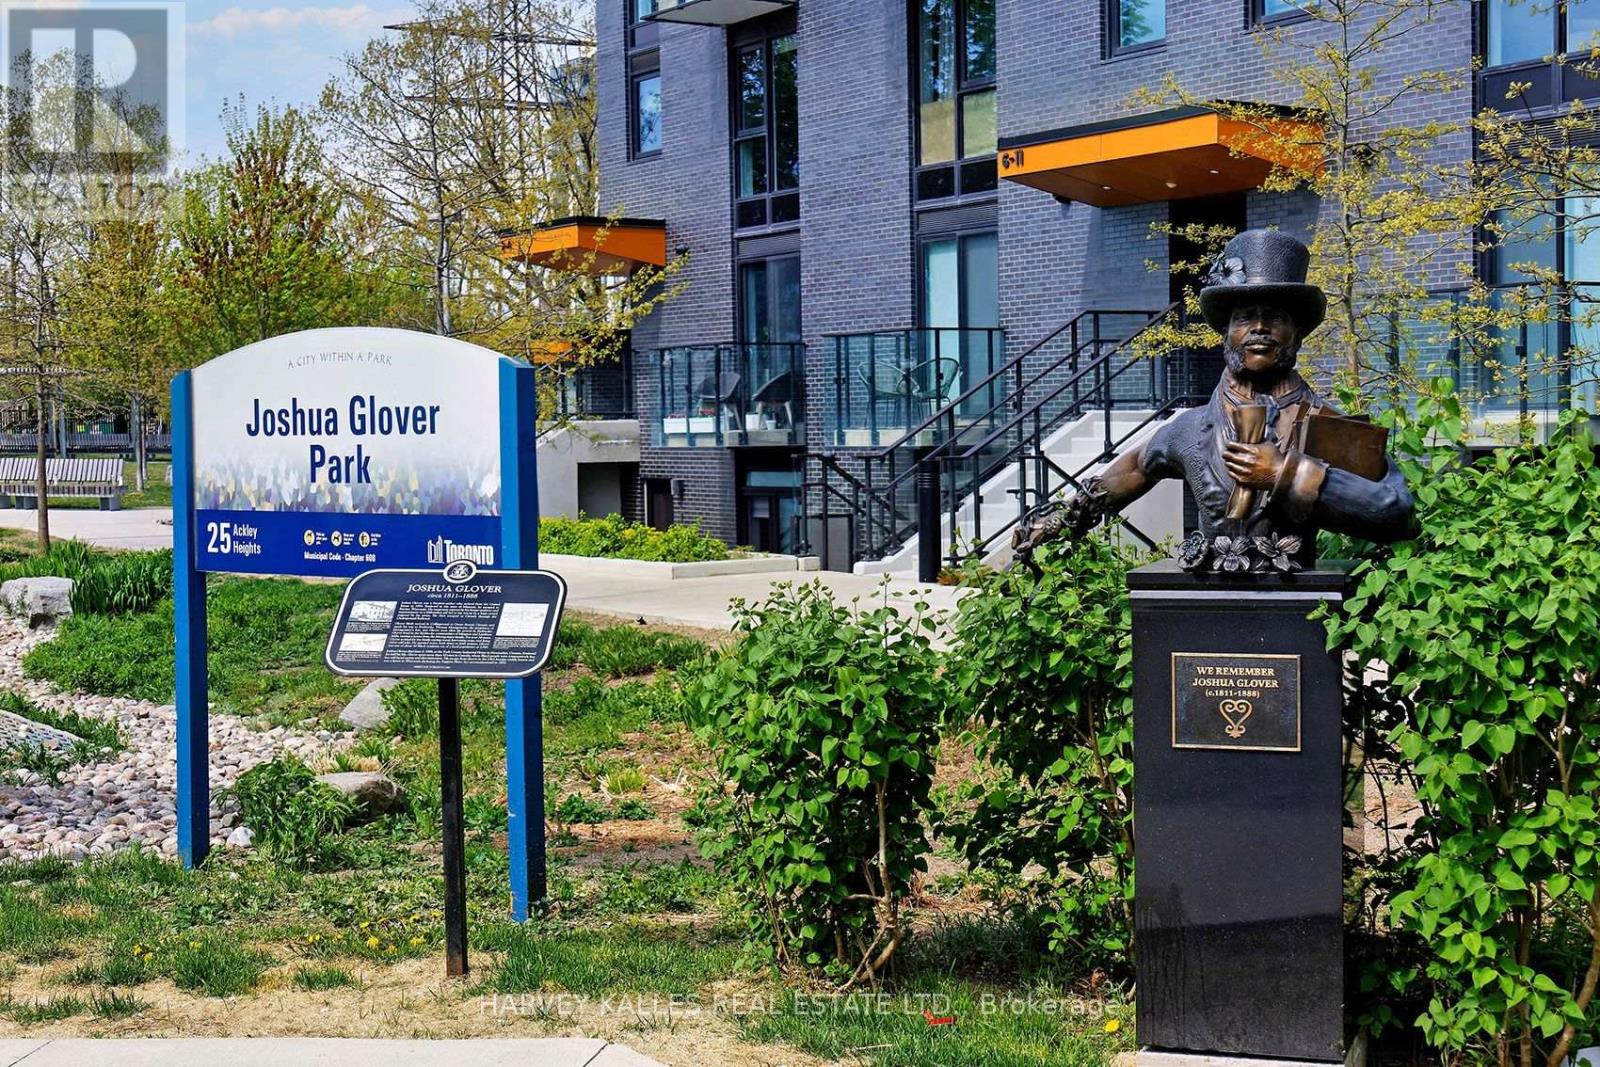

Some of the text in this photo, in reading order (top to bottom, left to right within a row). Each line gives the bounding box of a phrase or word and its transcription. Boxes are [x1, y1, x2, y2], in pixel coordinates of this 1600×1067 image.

[296, 354, 316, 366] CITY
[320, 352, 353, 362] WITHIN
[357, 353, 364, 362] A
[367, 352, 392, 366] PARK
[246, 395, 440, 437] Joshua Glover
[310, 445, 371, 484] Park
[207, 521, 231, 554] 25
[233, 523, 258, 540] Ackley
[233, 540, 261, 557] Heights
[444, 539, 494, 566] TORONTO
[304, 551, 328, 562] Municipal
[329, 552, 341, 561] Code
[345, 553, 364, 563] Chapter
[406, 584, 502, 593] JOSHUA GLOVER
[1197, 667, 1275, 676] WE REMEMBER
[1192, 677, 1279, 688] JOSHUA GLOVER
[1205, 689, 1260, 699] (c.1811-1888)
